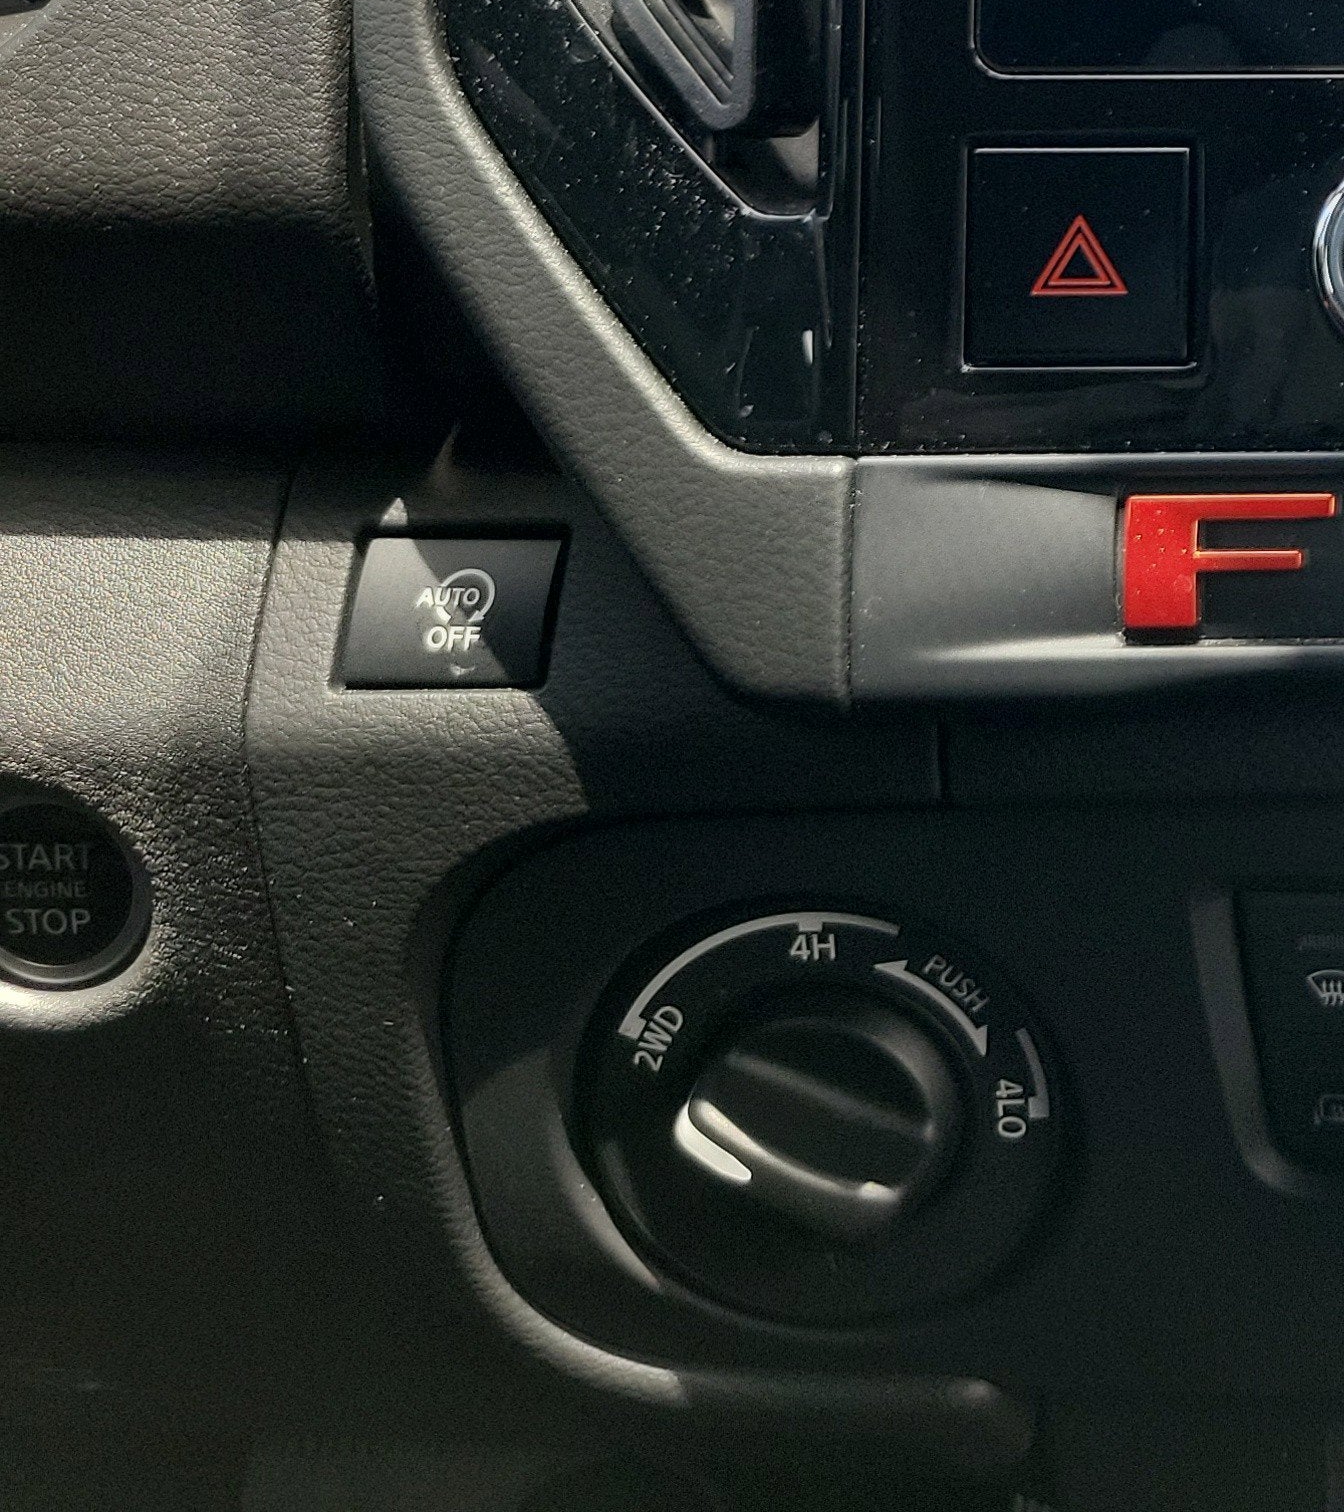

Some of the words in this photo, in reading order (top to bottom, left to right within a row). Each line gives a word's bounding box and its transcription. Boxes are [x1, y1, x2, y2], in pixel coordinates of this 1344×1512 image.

[416, 587, 480, 608] AUTO
[427, 626, 481, 651] OFF
[5, 908, 91, 935] STOP
[789, 934, 836, 961] 4H
[922, 953, 990, 1014] PUSH
[633, 1004, 684, 1072] 2WD
[996, 1078, 1026, 1139] 4LO
